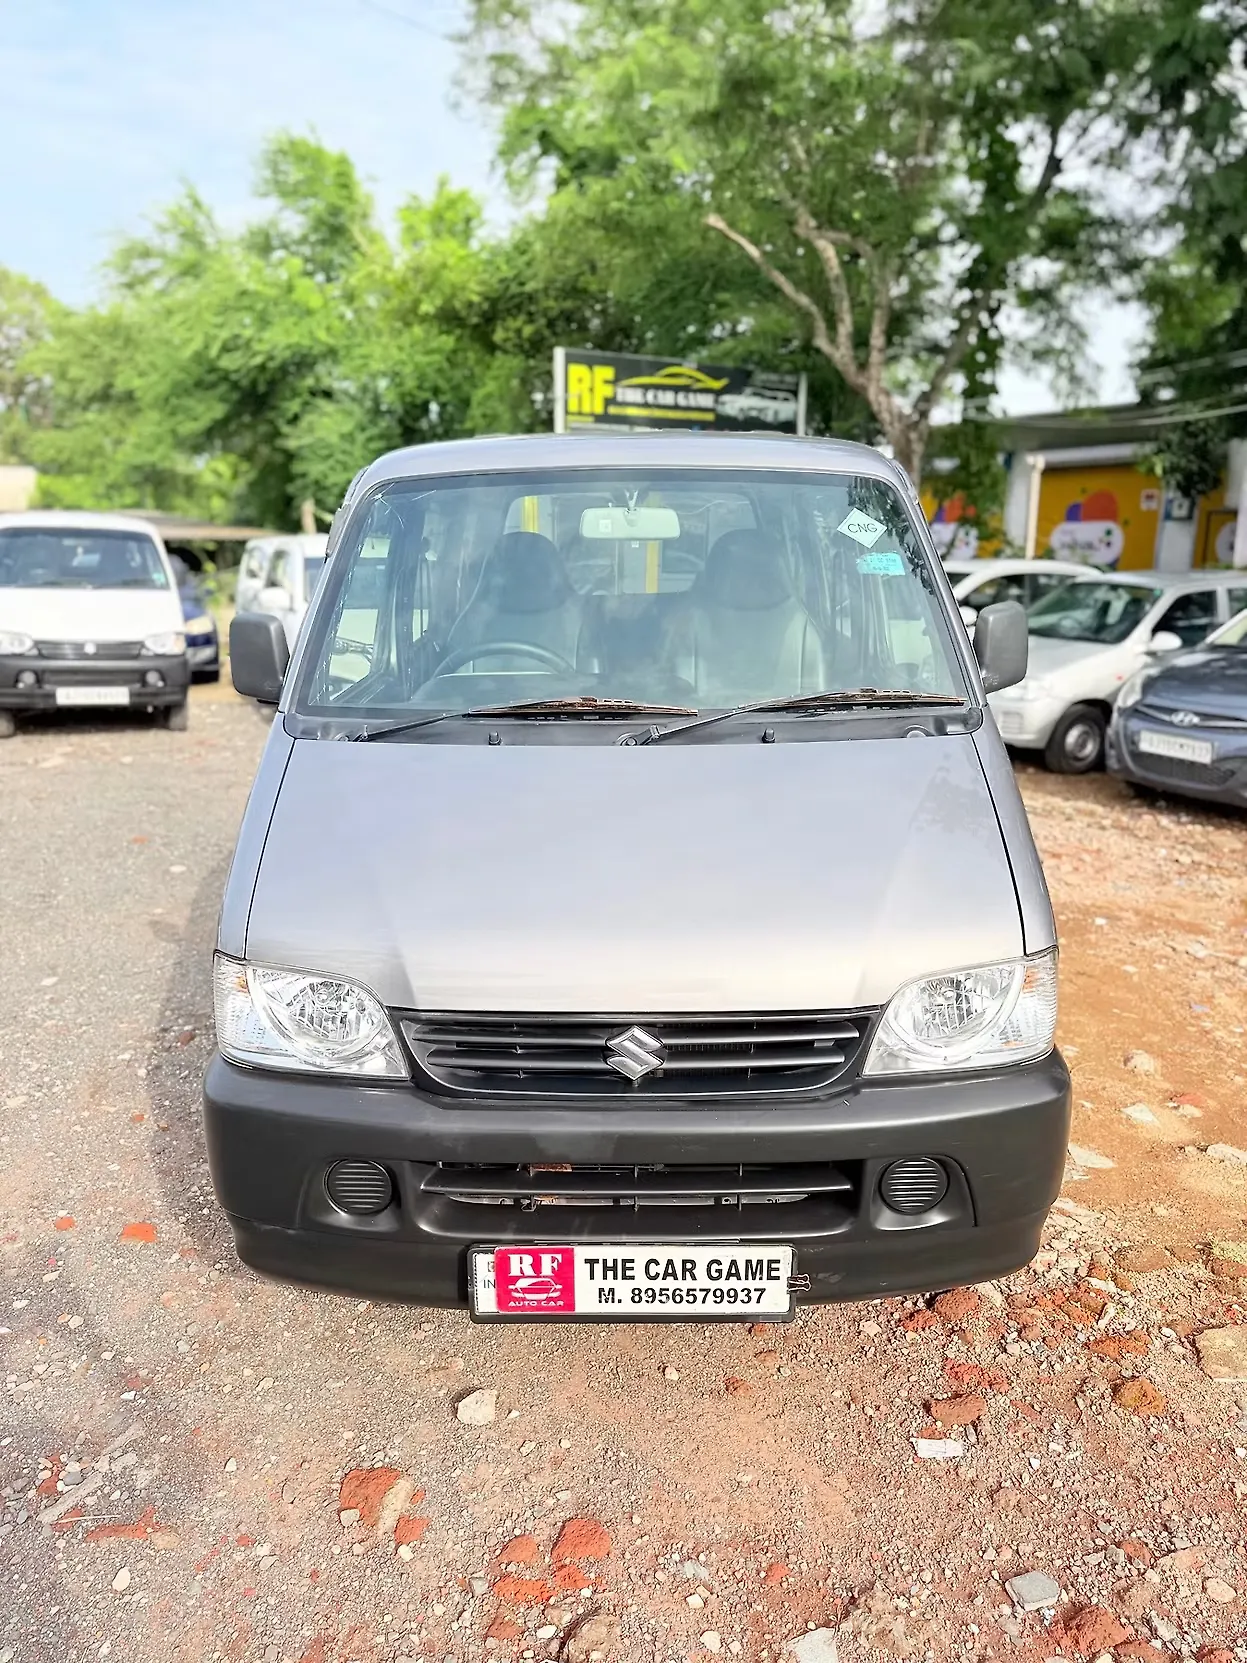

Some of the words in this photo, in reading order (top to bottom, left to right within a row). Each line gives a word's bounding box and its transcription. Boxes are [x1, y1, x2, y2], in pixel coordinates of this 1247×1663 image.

[567, 363, 616, 415] RF
[847, 523, 878, 533] CNG
[507, 1253, 562, 1277] RF
[584, 1259, 635, 1281] THE
[644, 1258, 697, 1281] CAR
[705, 1258, 781, 1281] GAME
[483, 1279, 496, 1289] IN
[598, 1288, 623, 1305] M.
[630, 1287, 767, 1305] 8956579937
